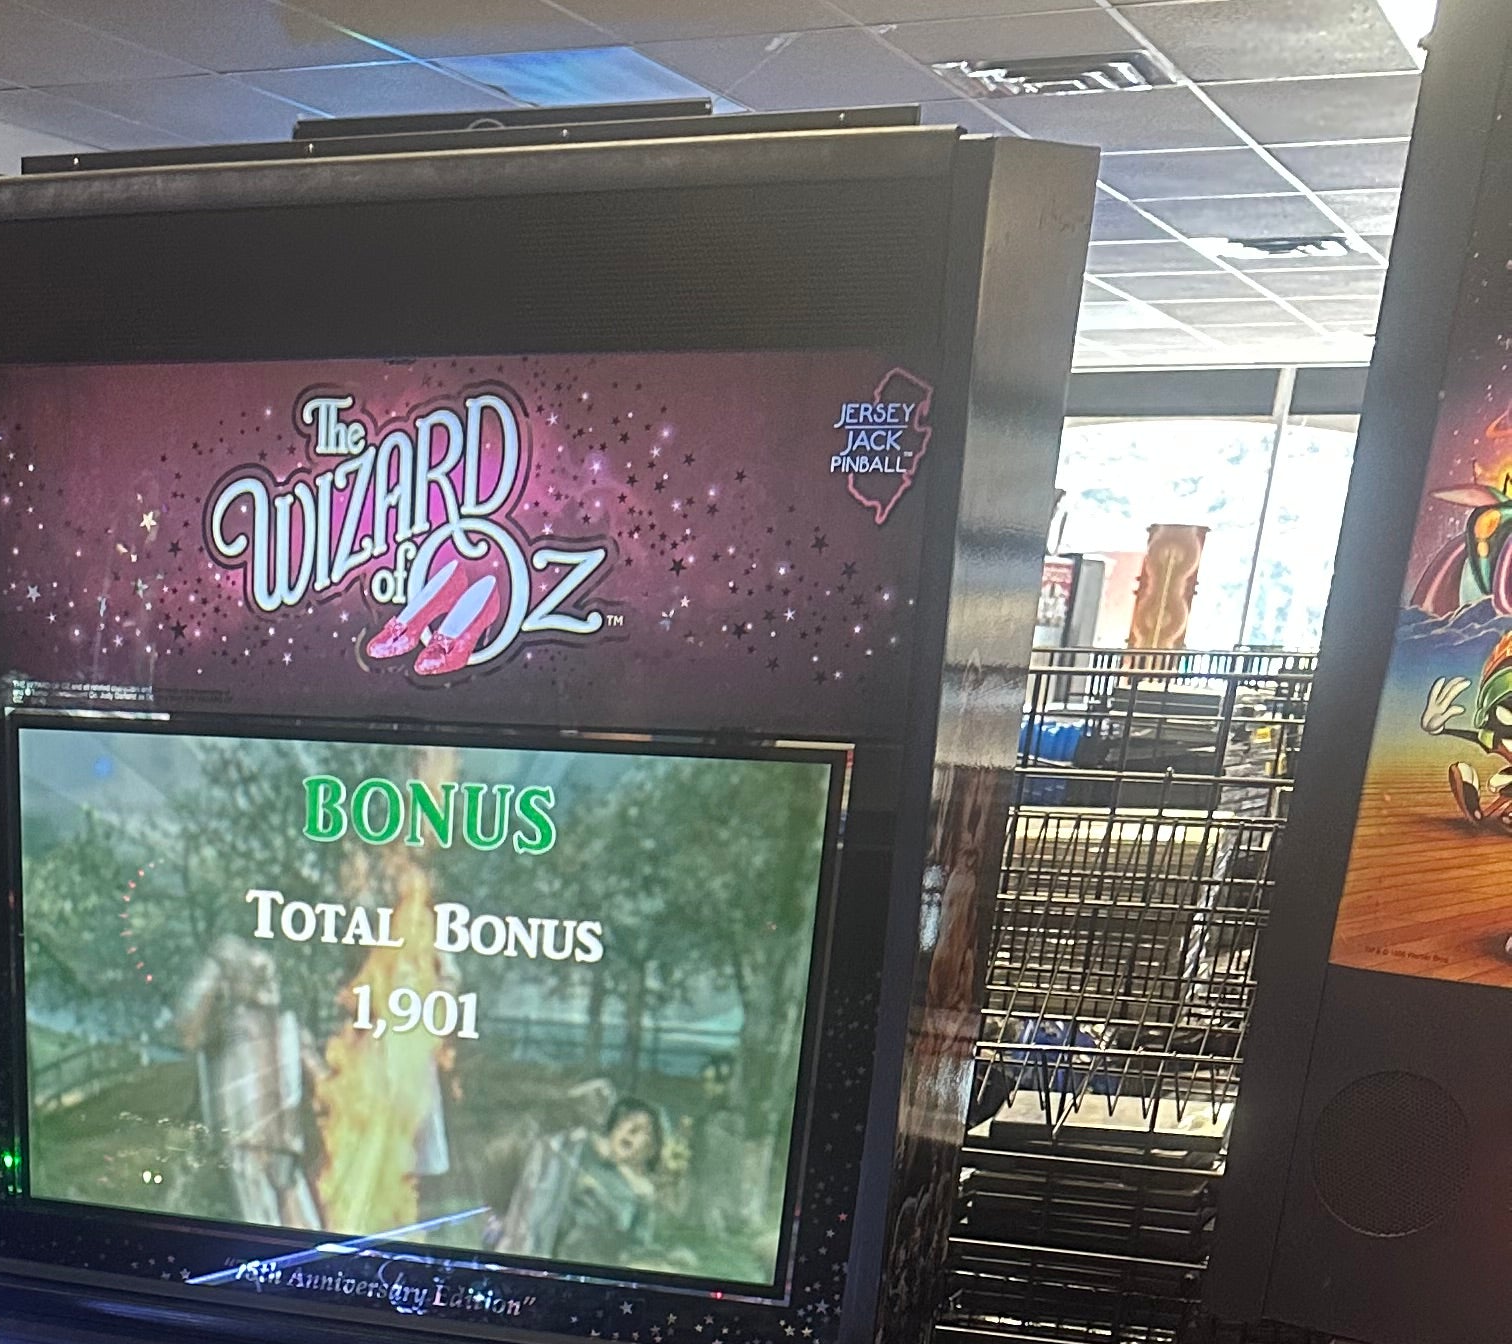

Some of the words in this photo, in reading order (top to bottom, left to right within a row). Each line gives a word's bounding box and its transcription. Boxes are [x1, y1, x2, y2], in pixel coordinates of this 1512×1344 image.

[304, 394, 366, 456] The
[833, 402, 916, 428] JERSEY
[840, 430, 904, 456] JACK
[830, 456, 907, 473] PINBALL
[211, 394, 521, 612] WIZARD
[372, 541, 417, 604] of
[407, 517, 606, 666] Oz
[301, 773, 558, 857] BONUS
[351, 983, 481, 1041] 1,901
[287, 1270, 429, 1313] Anniversary
